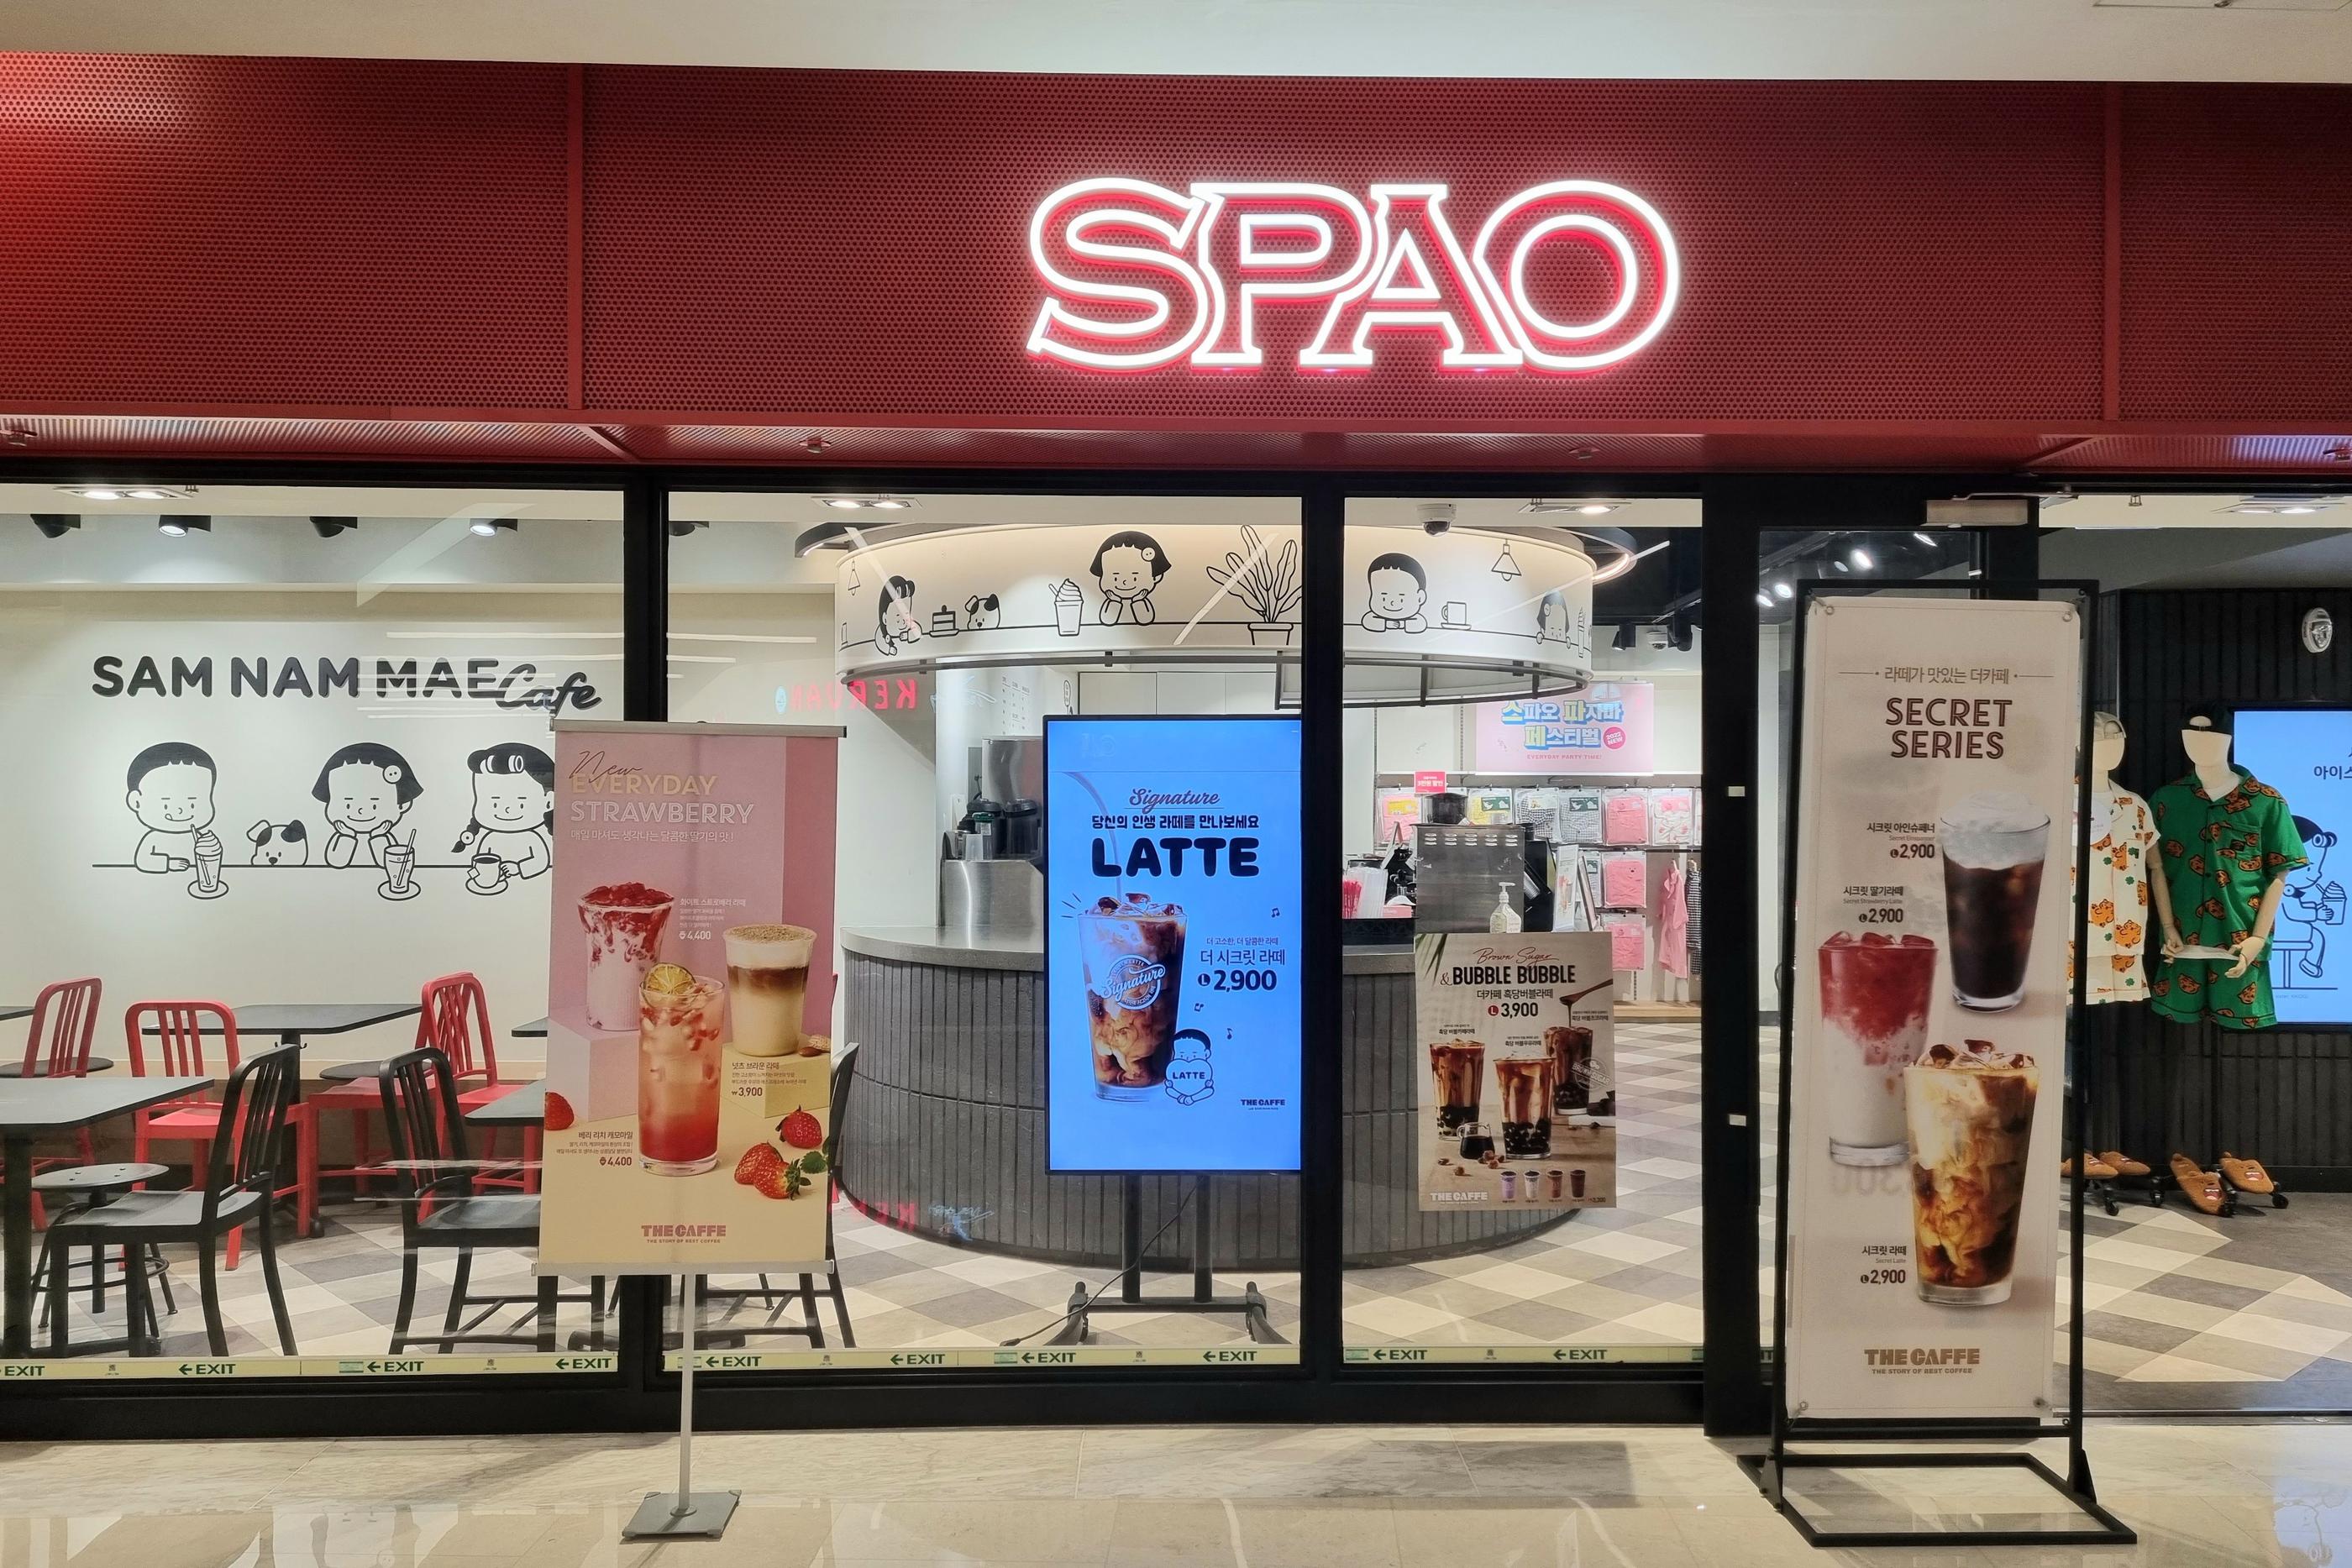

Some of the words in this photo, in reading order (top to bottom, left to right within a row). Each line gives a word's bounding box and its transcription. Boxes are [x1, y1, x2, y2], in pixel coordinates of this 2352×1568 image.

[1026, 176, 1681, 370] SPAO
[1884, 667, 1924, 683] 라떼가
[1928, 668, 1966, 684] 맛있는
[1971, 669, 2009, 684] 더카페
[92, 655, 213, 697] SAM
[230, 656, 360, 698] NAM
[375, 658, 501, 699] MAE
[496, 663, 602, 716] Cafe
[1502, 701, 1559, 723] 스파오
[1563, 700, 1625, 723] 파자마
[1886, 697, 2013, 726] SECRET
[1524, 725, 1601, 749] 페스티벌
[1608, 737, 1623, 745] NEW
[1891, 730, 2004, 759] SERIES
[569, 750, 643, 784] New
[571, 774, 717, 795] EVERYDAY
[1129, 788, 1220, 814] Signature
[570, 801, 754, 824] STRAWBERRY
[1092, 815, 1127, 829] 당신의
[1132, 815, 1156, 829] 인생
[1159, 815, 1194, 829] 라떼를
[1199, 815, 1259, 829] 만나보세요
[1866, 823, 1892, 833] 시크릿
[1894, 823, 1935, 833] 아인슈페너
[571, 830, 590, 841] 매일
[591, 830, 620, 841] 마셔도
[622, 830, 659, 842] 생각나는
[661, 831, 688, 842] 달콤한
[690, 831, 717, 842] 딸기의
[1092, 837, 1259, 877] LATTE
[1899, 844, 1935, 859] 2,900
[1843, 886, 1867, 896] 시크릿
[1870, 886, 1903, 896] 딸기라떼
[1868, 909, 1903, 924] 2,900
[687, 931, 711, 940] 4,400
[1245, 936, 1263, 946] 달콤한
[1200, 949, 1213, 965] 더
[1217, 949, 1255, 965] 시크릿
[1259, 949, 1285, 965] 라떼
[1473, 947, 1514, 964] Brown
[1515, 947, 1559, 968] Sugar
[1214, 969, 1277, 992] 2,900
[1453, 967, 1511, 985] BUBBLE
[1517, 965, 1576, 983] BUBBLE
[1101, 964, 1165, 1001] Signature
[1477, 989, 1501, 999] 더카페
[1504, 989, 1553, 999] 흑당버블라떼
[1501, 1003, 1538, 1018] 3,900
[607, 1131, 633, 1140] 캐모마일
[607, 1156, 632, 1167] 4,400
[1430, 1192, 1452, 1201] THE
[1453, 1192, 1488, 1201] CAFFE
[641, 1225, 673, 1237] THE
[675, 1225, 726, 1237] CAFFE
[1861, 1245, 1887, 1256] 시크릿
[1889, 1245, 1907, 1256] 라떼
[1870, 1269, 1906, 1285] 2,900
[722, 1356, 762, 1367] EXIT
[906, 1354, 946, 1365] EXIT
[1037, 1352, 1076, 1363] EXIT
[1218, 1350, 1257, 1361] EXIT
[1389, 1350, 1428, 1361] EXIT
[1568, 1349, 1608, 1360] EXIT
[1864, 1349, 1908, 1365] THE
[1910, 1348, 1980, 1366] CAFFE
[196, 1364, 236, 1375] EXIT
[384, 1361, 423, 1371] EXIT
[571, 1358, 612, 1369] EXIT
[4, 1366, 45, 1377] EXIT
